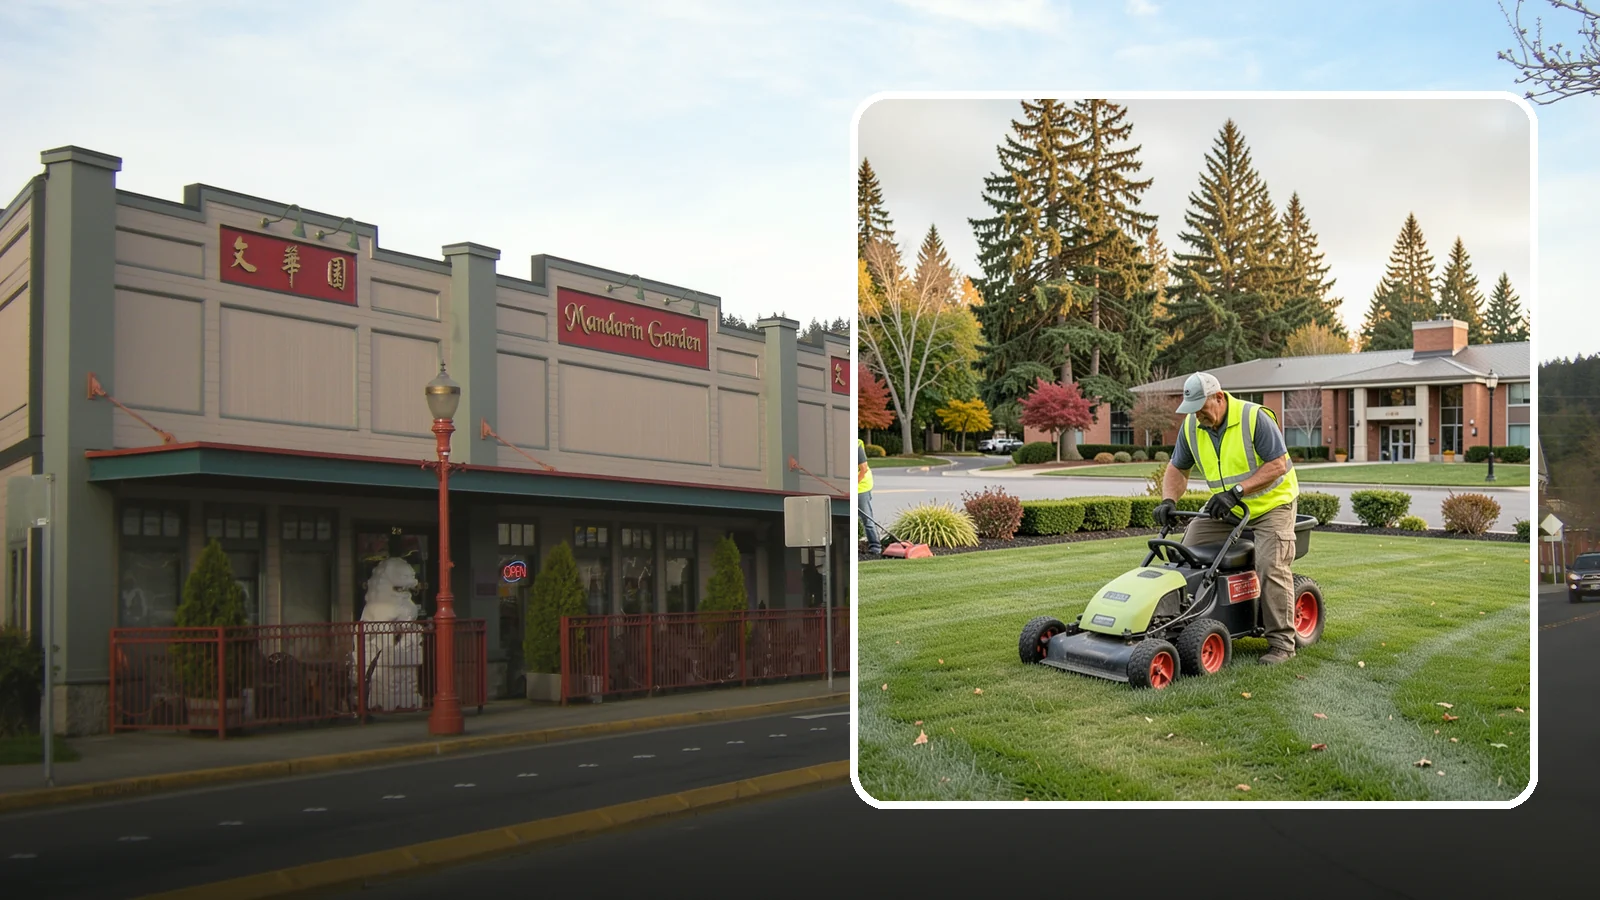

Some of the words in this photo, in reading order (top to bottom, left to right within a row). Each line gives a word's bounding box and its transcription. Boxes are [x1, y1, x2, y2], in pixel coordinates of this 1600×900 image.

[231, 236, 347, 291] 文華園
[565, 303, 644, 340] Mandarin
[648, 320, 701, 352] Garden
[503, 565, 527, 578] OPEN
